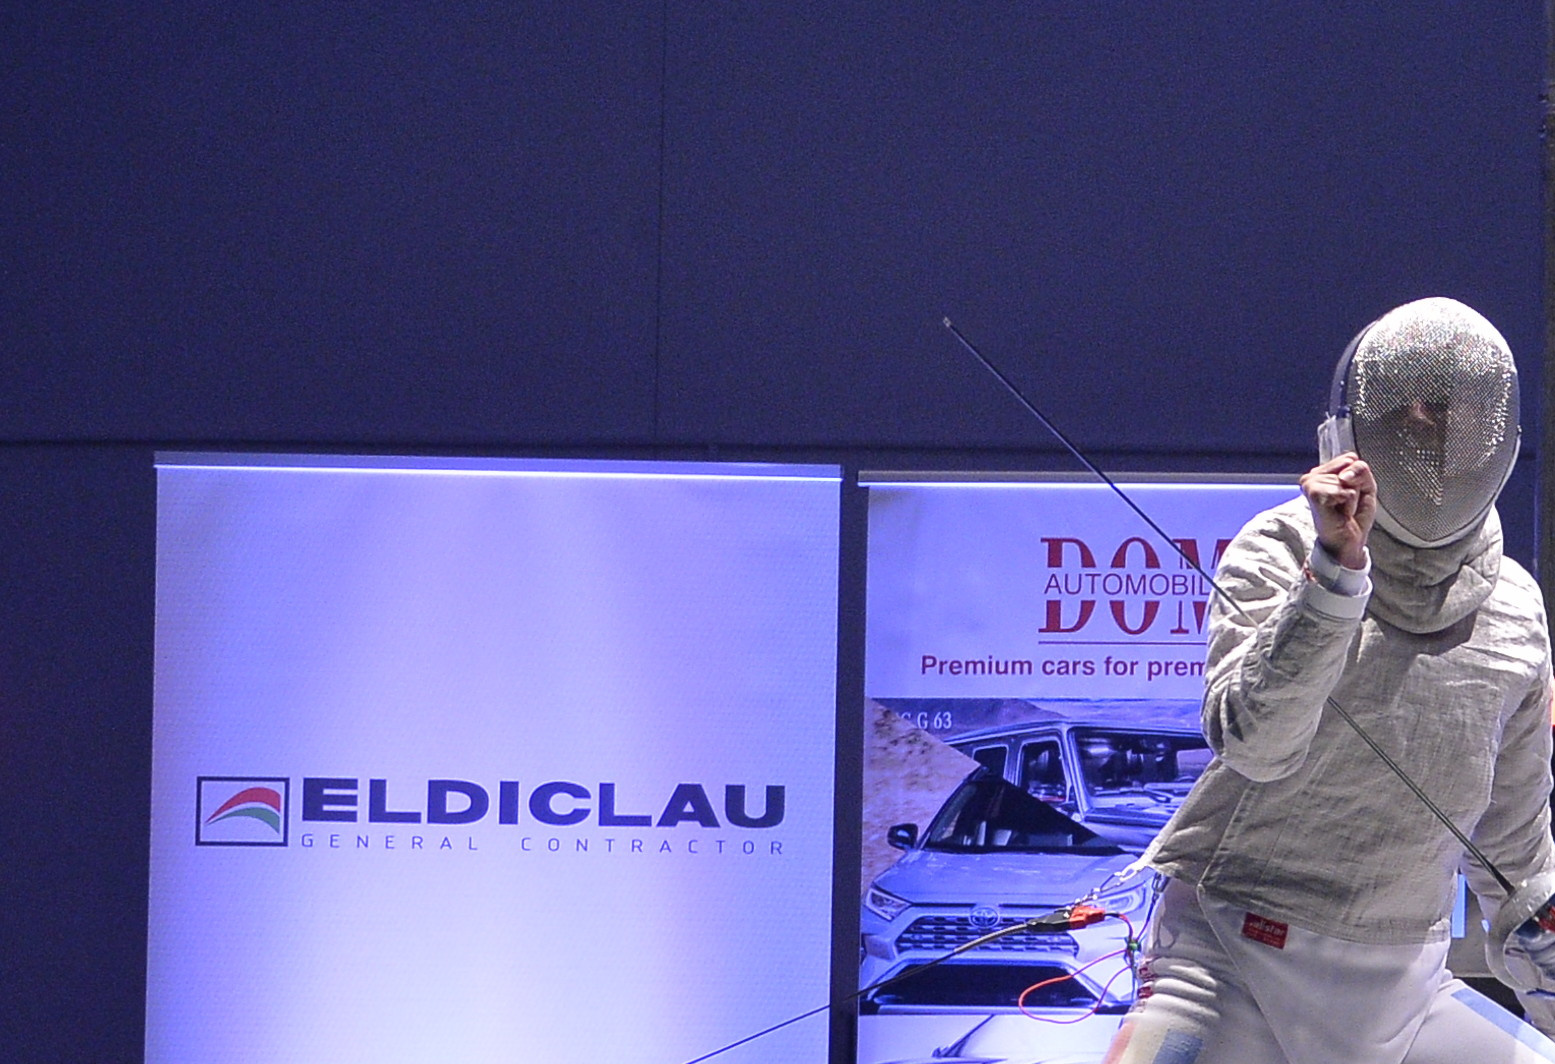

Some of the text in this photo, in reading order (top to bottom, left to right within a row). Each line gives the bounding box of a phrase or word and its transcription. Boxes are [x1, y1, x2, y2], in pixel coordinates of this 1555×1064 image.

[1045, 572, 1210, 596] AUTOMOBIL
[921, 655, 1206, 681] Premium cars for prem
[933, 711, 952, 729] 63
[302, 777, 786, 829] ELDICLAU
[301, 833, 784, 856] GENERAL CONTRACTOR
